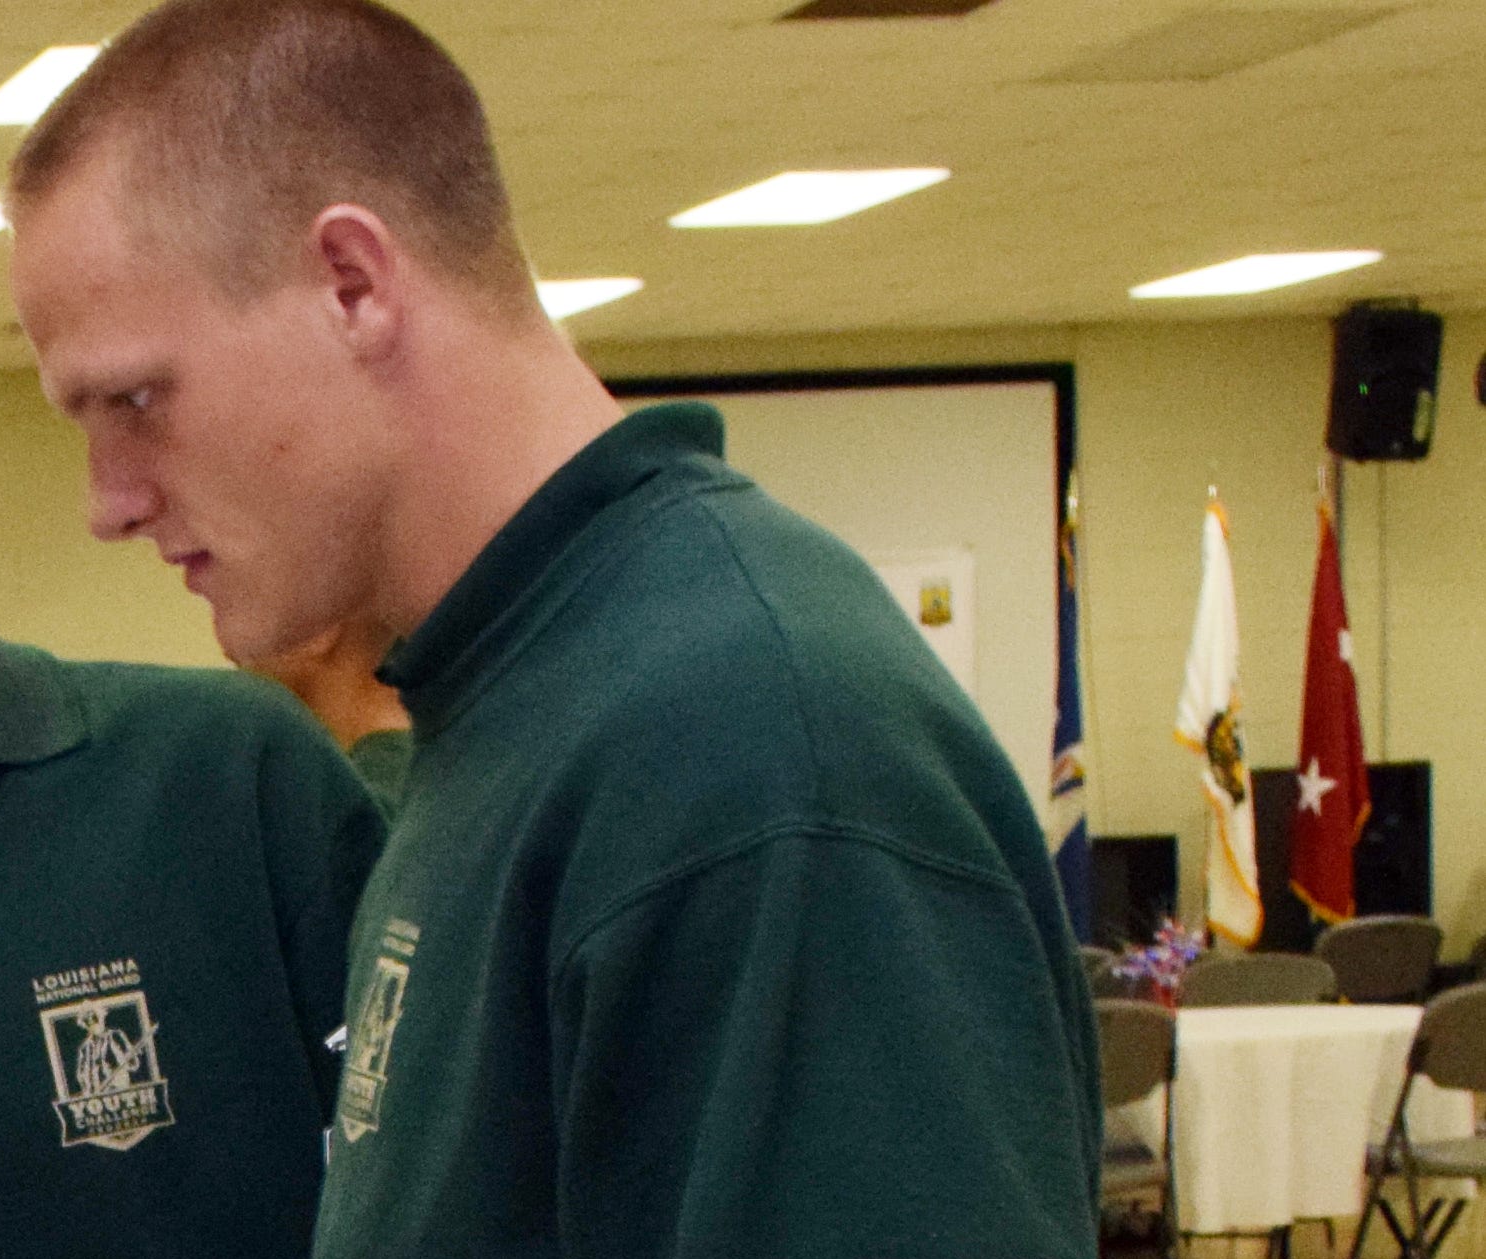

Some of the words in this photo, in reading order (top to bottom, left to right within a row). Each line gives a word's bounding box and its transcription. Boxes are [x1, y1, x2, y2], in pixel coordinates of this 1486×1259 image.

[33, 958, 139, 992] LOUISIANA
[36, 982, 98, 1004] NATIONAL
[99, 972, 141, 991] GUARD
[68, 1086, 157, 1121] YOUTH
